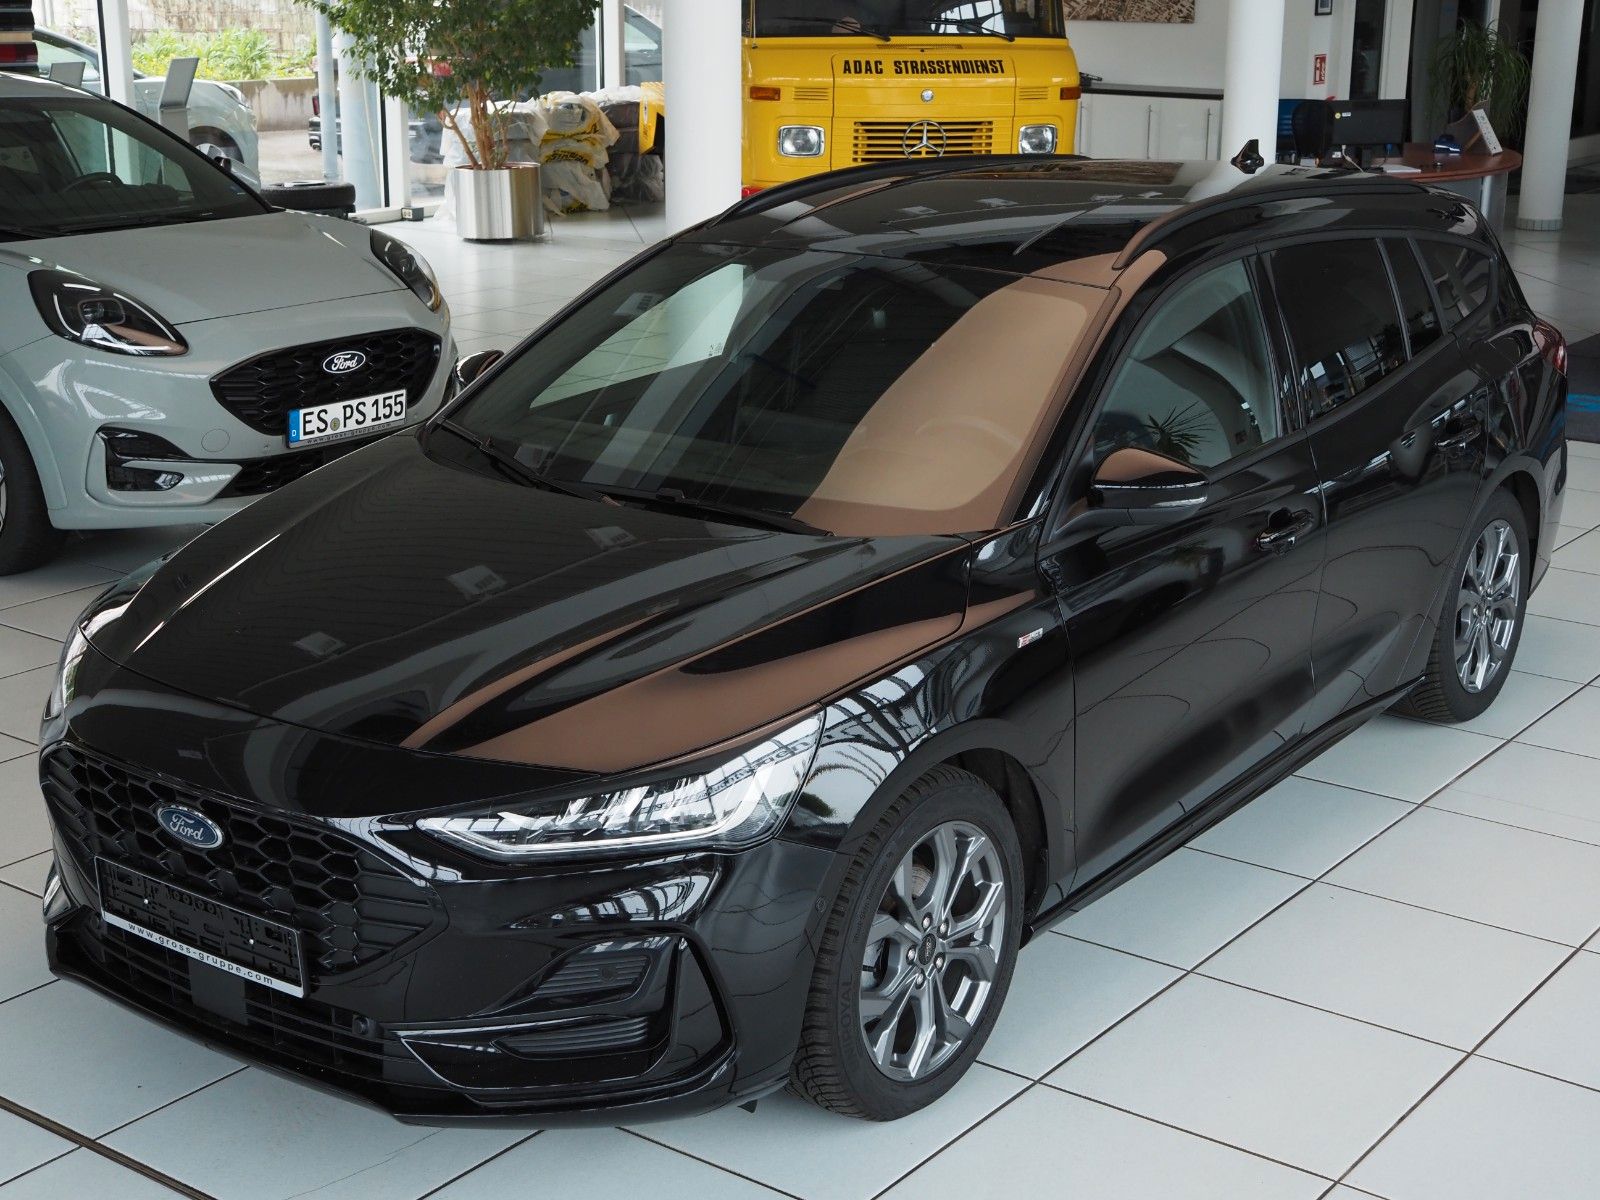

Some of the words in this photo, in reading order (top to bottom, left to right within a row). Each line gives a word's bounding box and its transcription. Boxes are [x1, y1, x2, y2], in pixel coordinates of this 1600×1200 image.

[843, 60, 884, 74] ADAC
[894, 59, 1005, 74] STRASSENDIENST
[331, 353, 359, 371] Ford
[302, 408, 329, 436] ES
[342, 401, 367, 428] PS
[371, 393, 404, 422] 155
[169, 813, 205, 841] Ford
[128, 922, 273, 985] www.gross-gruppe.com
